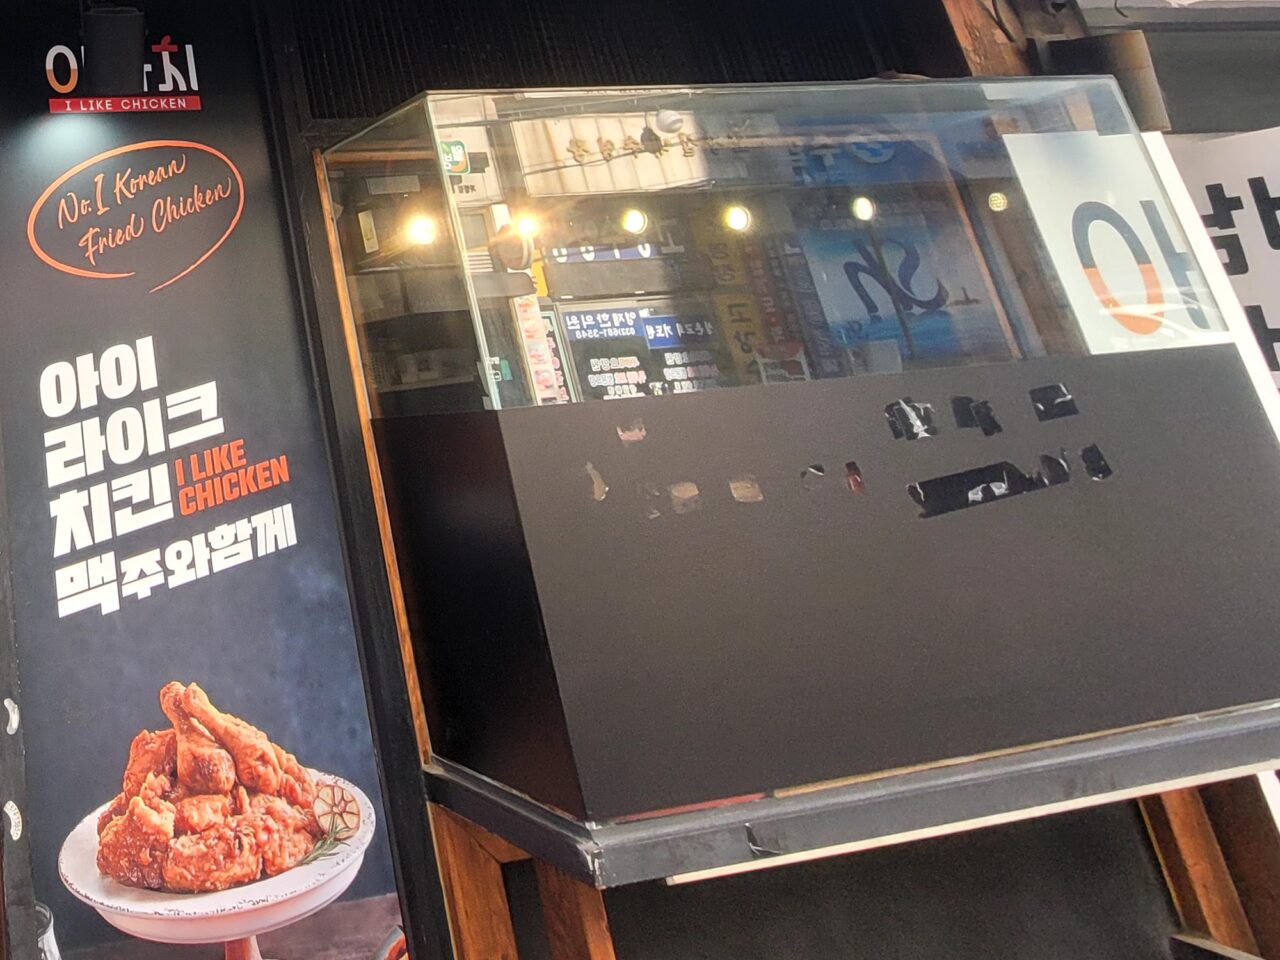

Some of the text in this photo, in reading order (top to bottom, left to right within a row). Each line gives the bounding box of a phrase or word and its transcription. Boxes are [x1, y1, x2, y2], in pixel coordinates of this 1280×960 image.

[65, 97, 187, 111] I LIKE CHICKEN
[114, 154, 187, 205] Korean
[78, 177, 232, 266] Fried Chicken
[39, 335, 158, 418] 아이
[43, 380, 225, 488] 라이크
[174, 438, 247, 487] I LIKE
[49, 463, 174, 558] 치킨
[178, 454, 290, 518] CHICKEN
